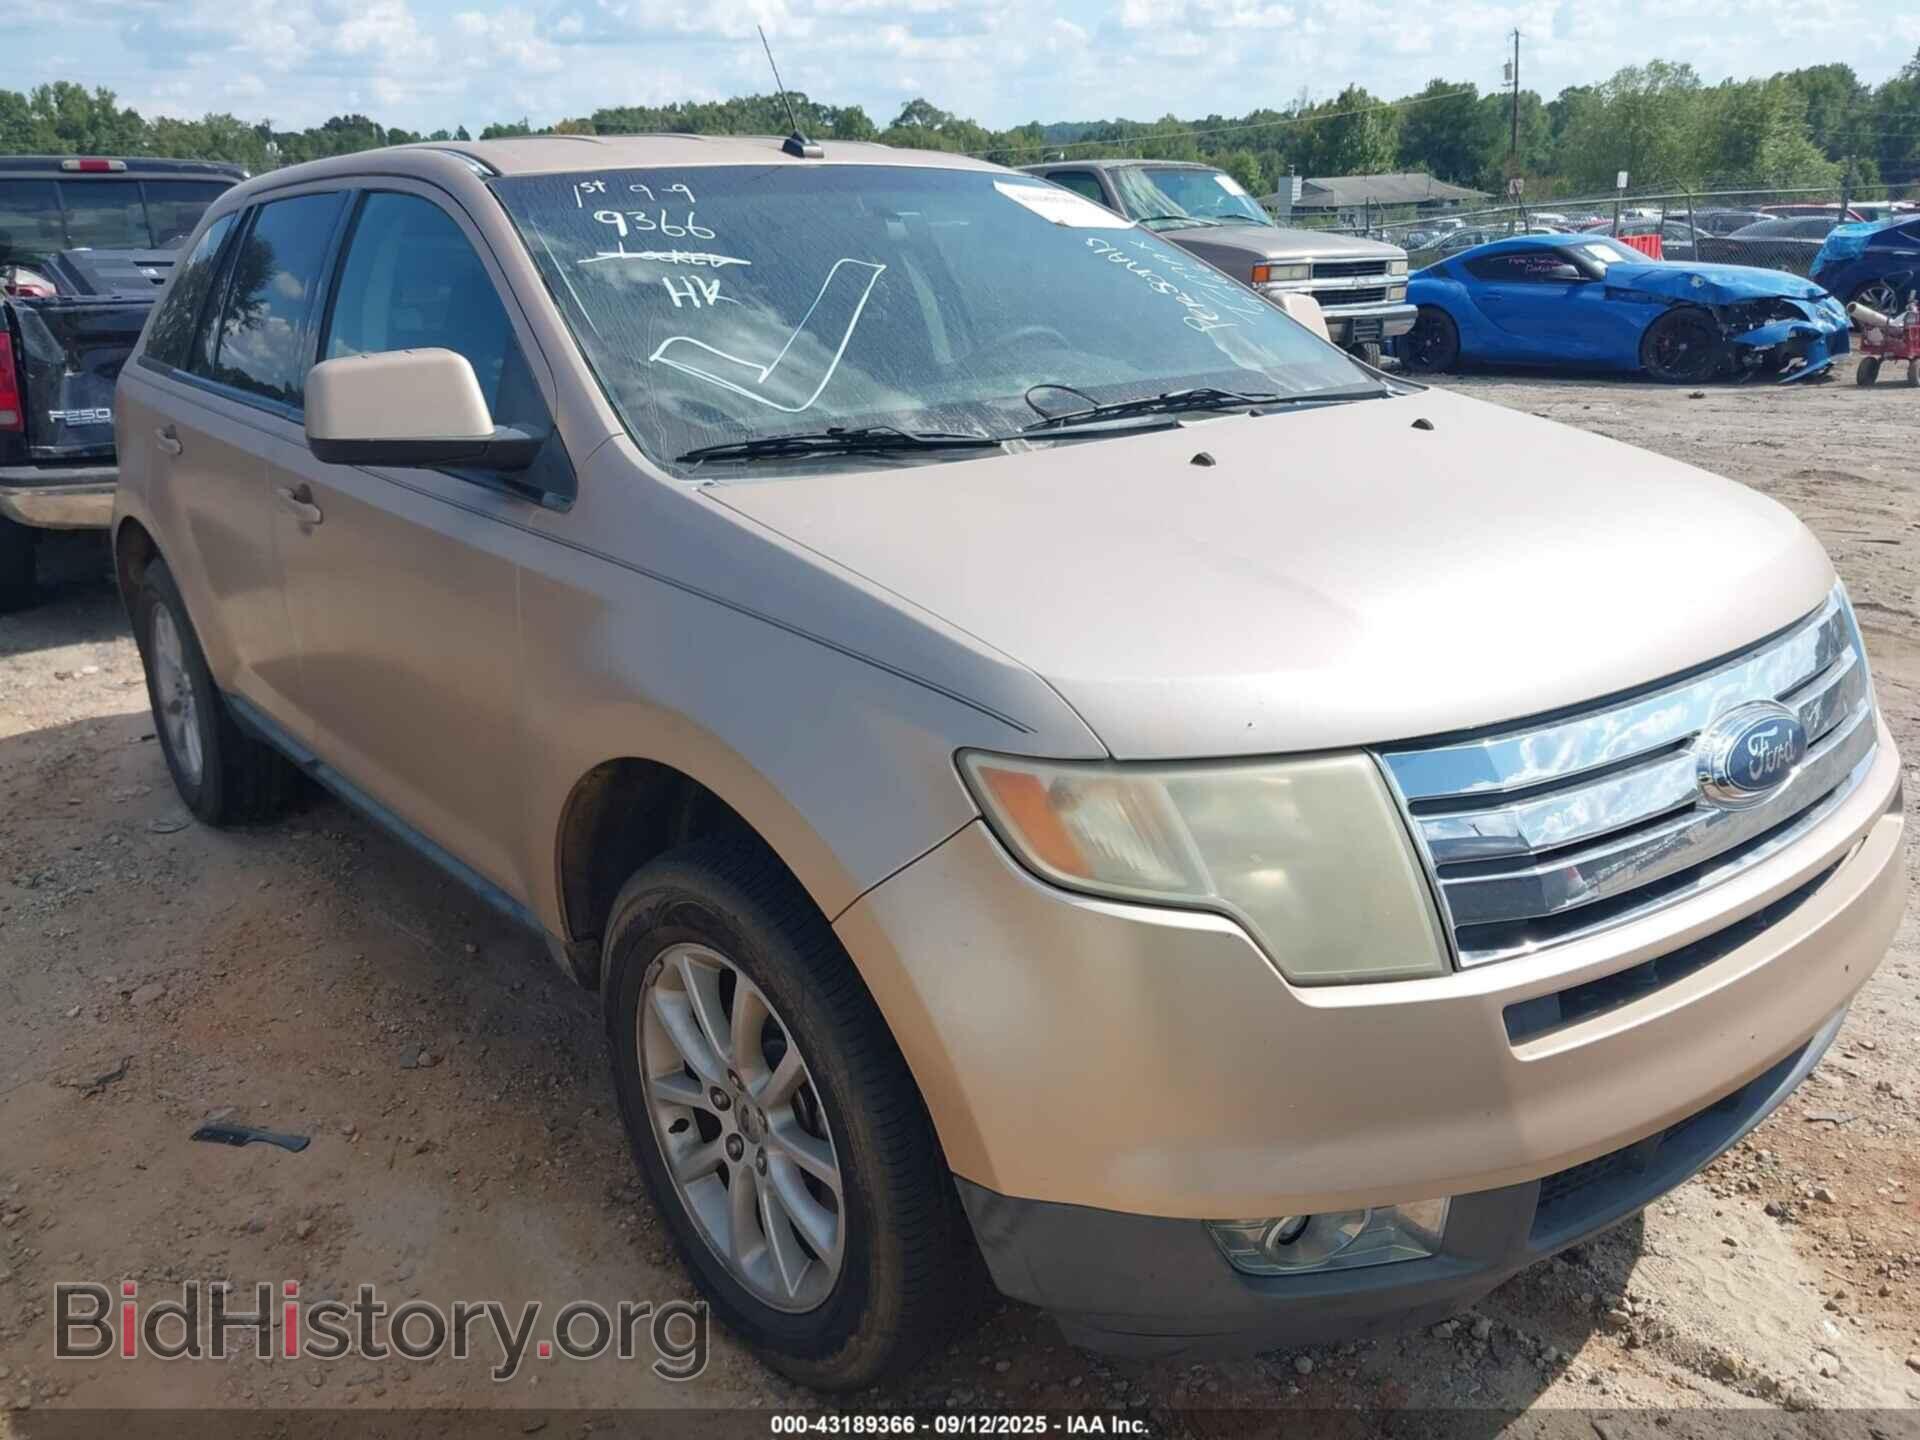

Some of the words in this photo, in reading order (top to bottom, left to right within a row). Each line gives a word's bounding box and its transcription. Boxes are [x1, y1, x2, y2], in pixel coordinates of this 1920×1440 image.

[574, 180, 606, 208] 1st
[593, 209, 716, 239] 9366
[47, 408, 111, 424] F250
[1748, 726, 1796, 781] Ford
